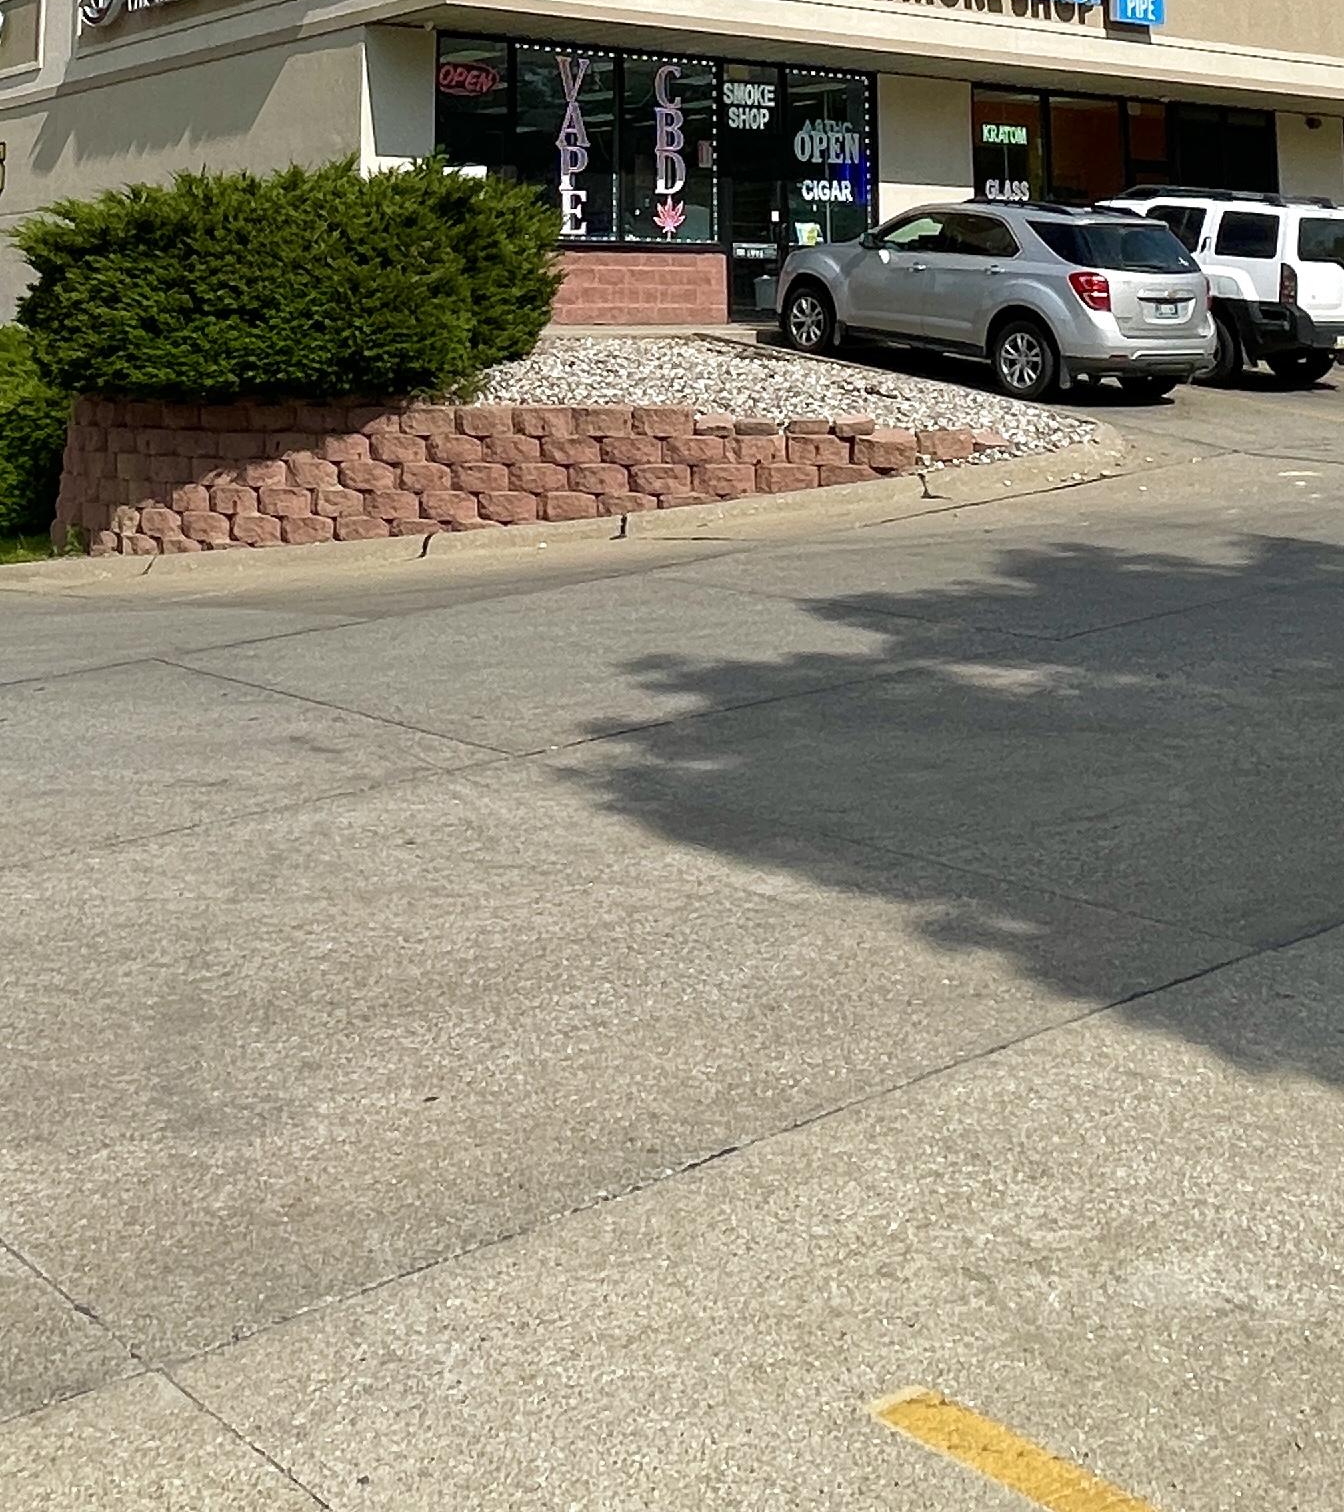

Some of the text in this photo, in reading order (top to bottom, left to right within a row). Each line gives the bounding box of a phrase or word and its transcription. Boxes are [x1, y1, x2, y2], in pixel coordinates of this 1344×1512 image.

[438, 62, 495, 93] OPEN
[722, 82, 776, 108] SMOKE
[654, 64, 687, 195] CBD
[728, 106, 770, 130] SHOP
[556, 56, 592, 236] VAPE
[793, 130, 860, 164] OPEN
[982, 123, 1028, 146] KRATOM
[801, 180, 854, 202] CIGAR
[985, 179, 1030, 202] GLASS
